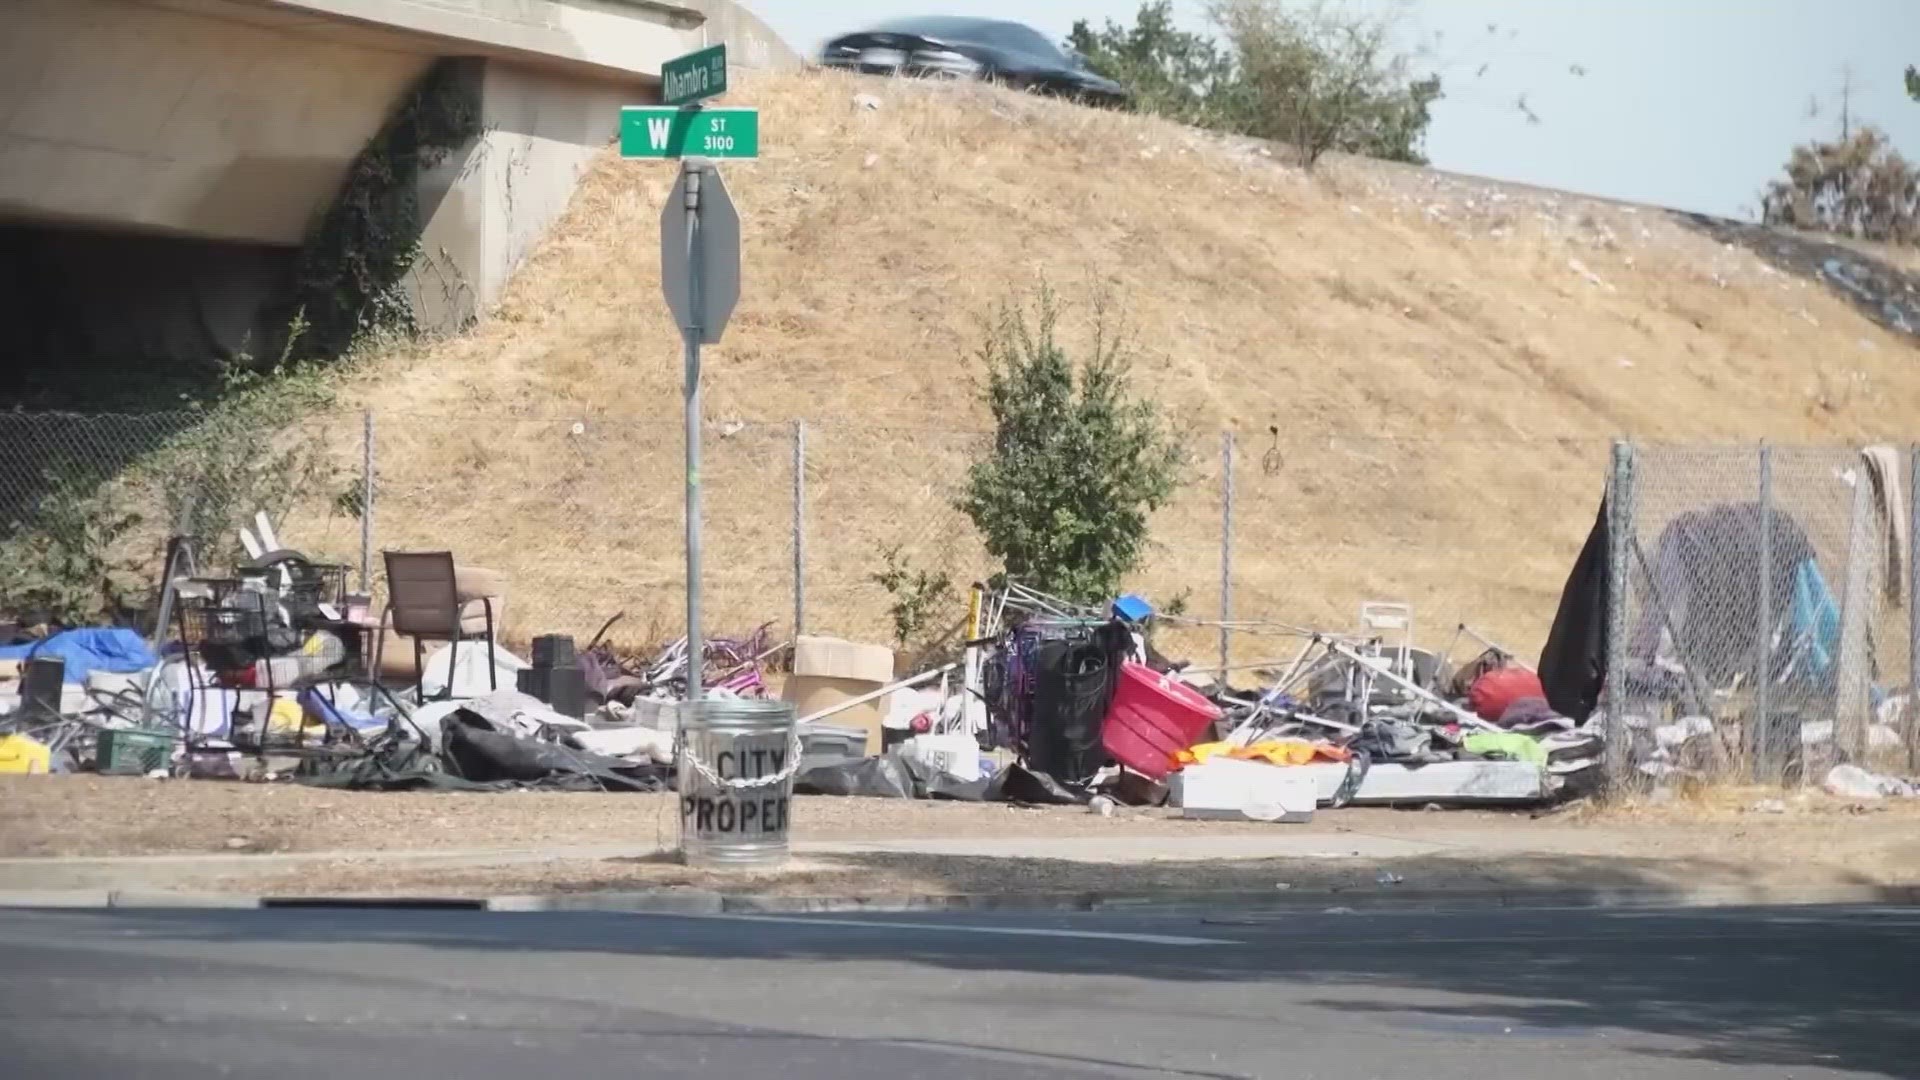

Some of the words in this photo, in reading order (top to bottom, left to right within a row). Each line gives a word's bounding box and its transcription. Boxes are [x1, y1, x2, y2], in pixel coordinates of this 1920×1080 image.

[663, 63, 709, 103] Alhambra
[647, 117, 671, 150] W
[710, 118, 726, 132] ST
[703, 135, 734, 150] 3100
[717, 749, 785, 780] CITY
